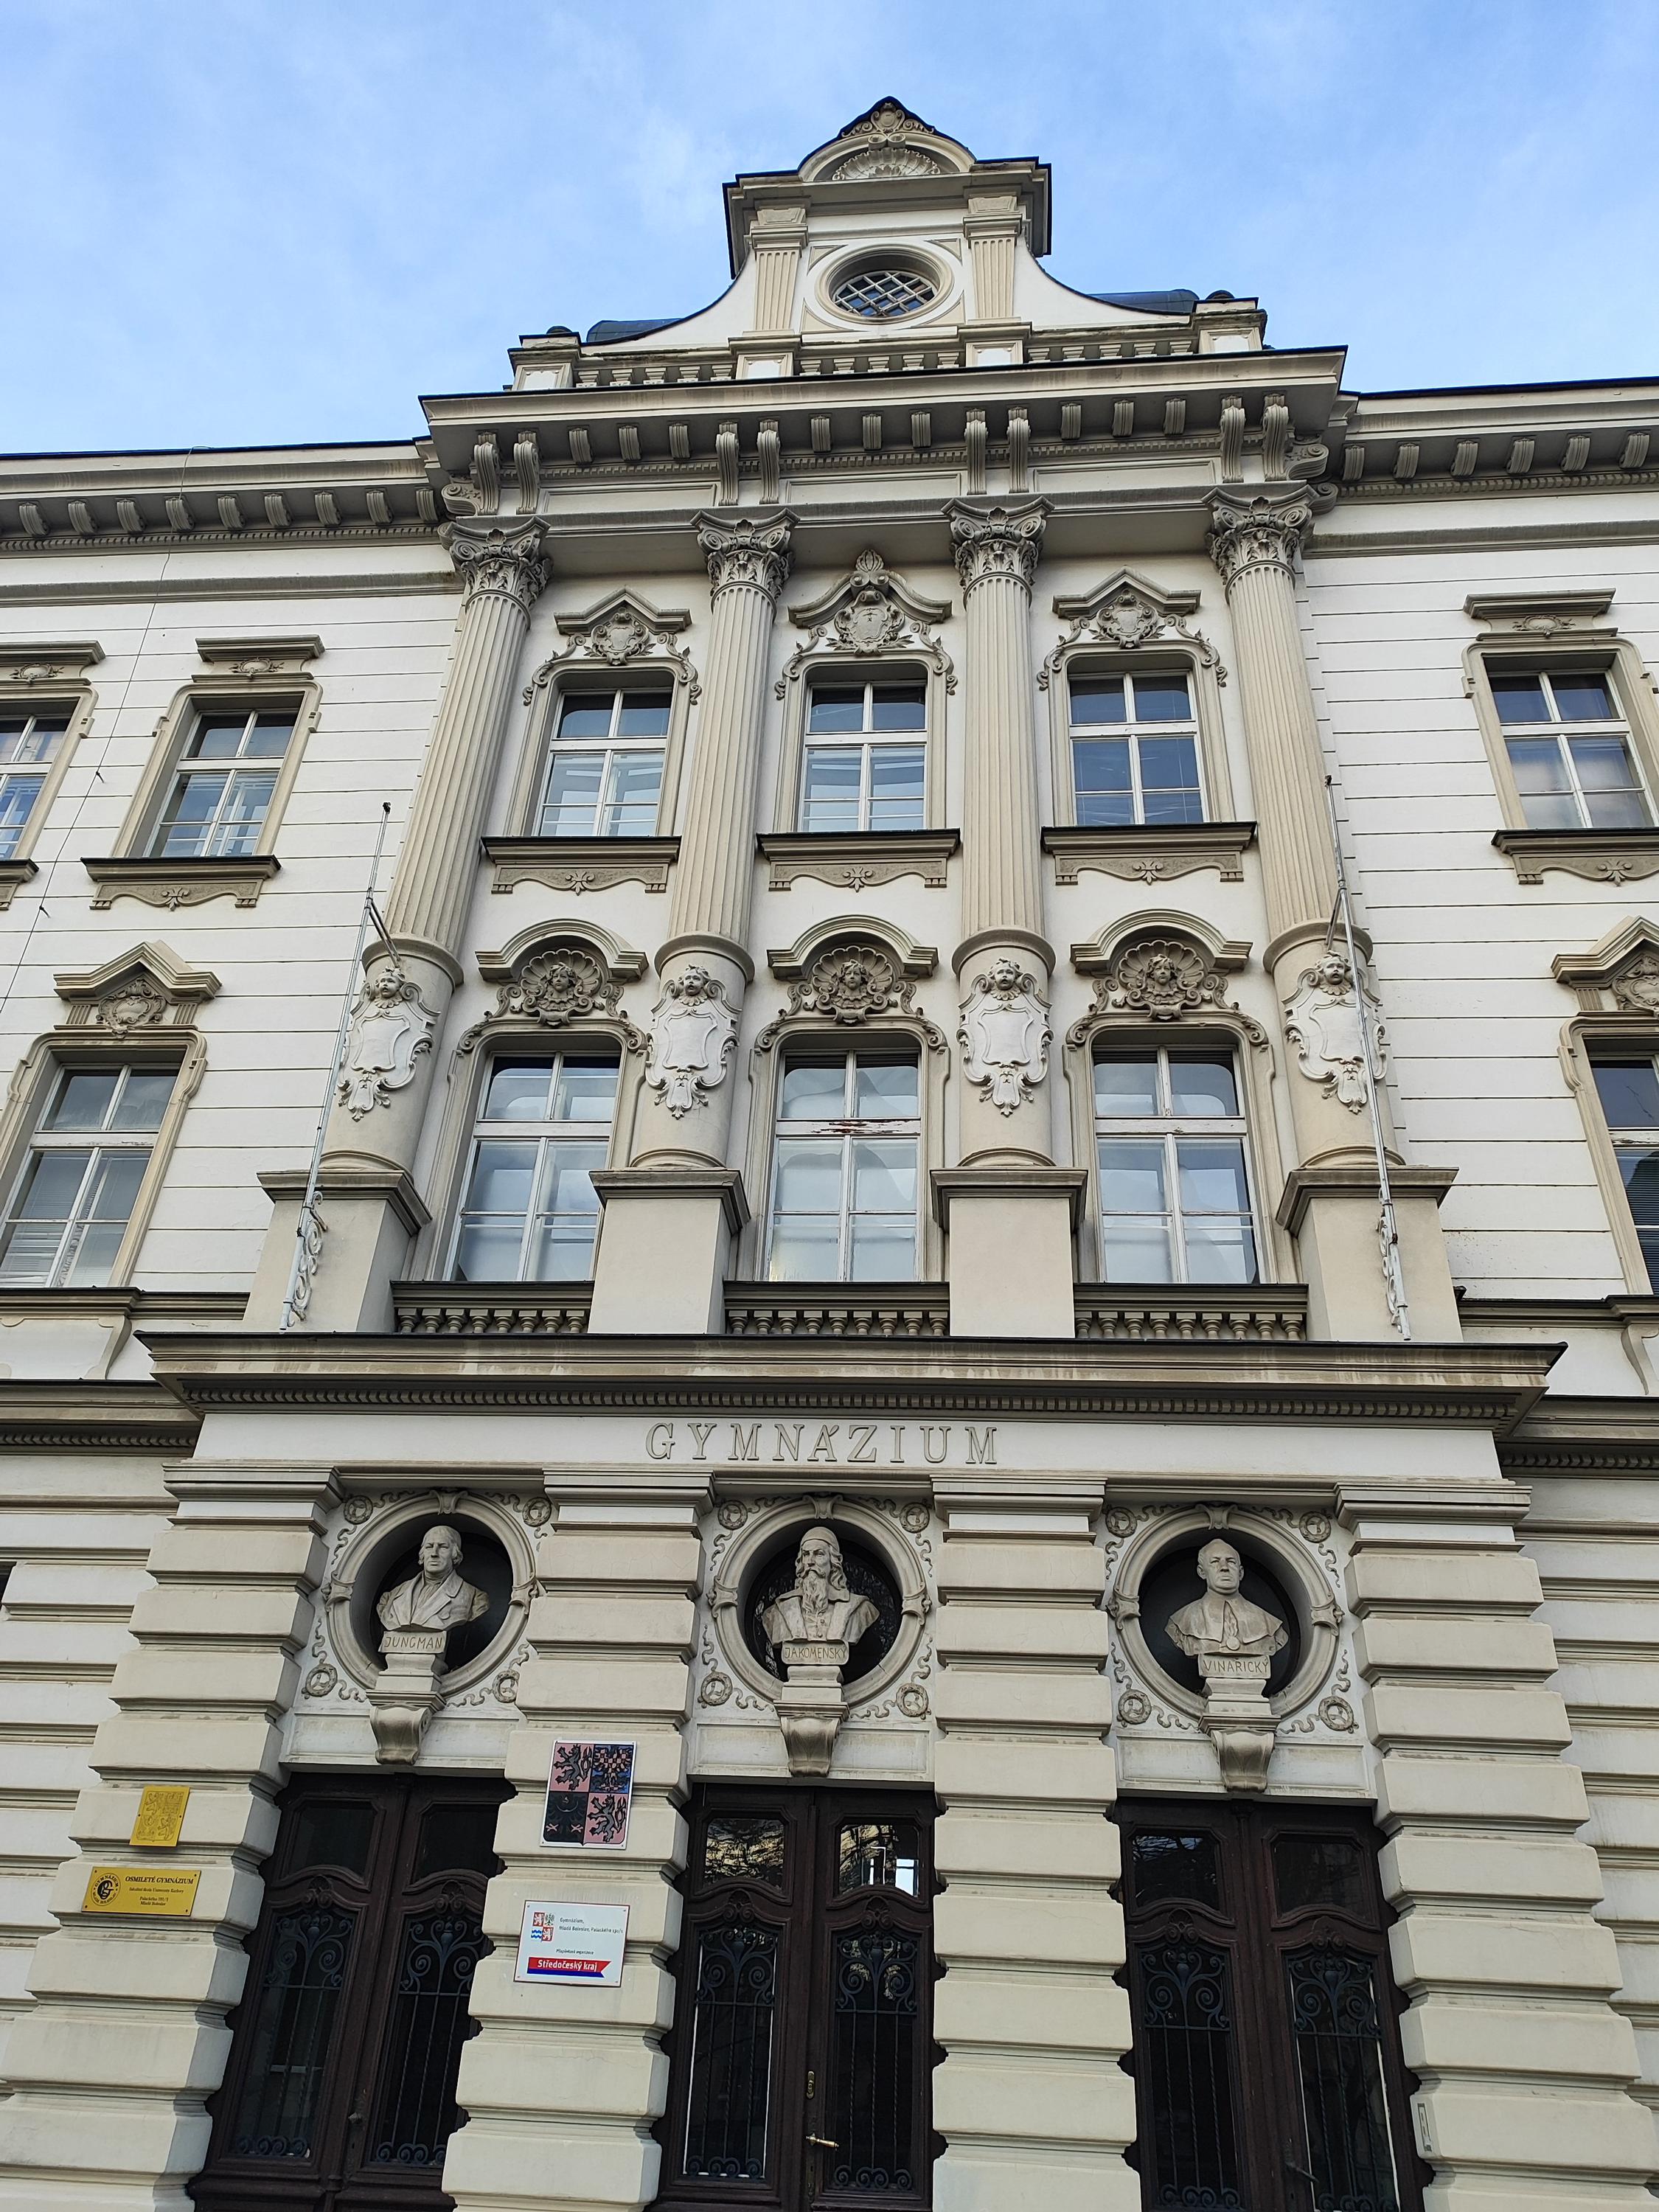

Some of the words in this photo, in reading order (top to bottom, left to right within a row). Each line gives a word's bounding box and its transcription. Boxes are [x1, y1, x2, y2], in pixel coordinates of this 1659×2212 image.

[645, 1422, 998, 1464] GYMNÁZIUM
[384, 1636, 443, 1649] JUNGMAN
[538, 1959, 582, 1971] Středočeský
[583, 1961, 597, 1972] kraj
